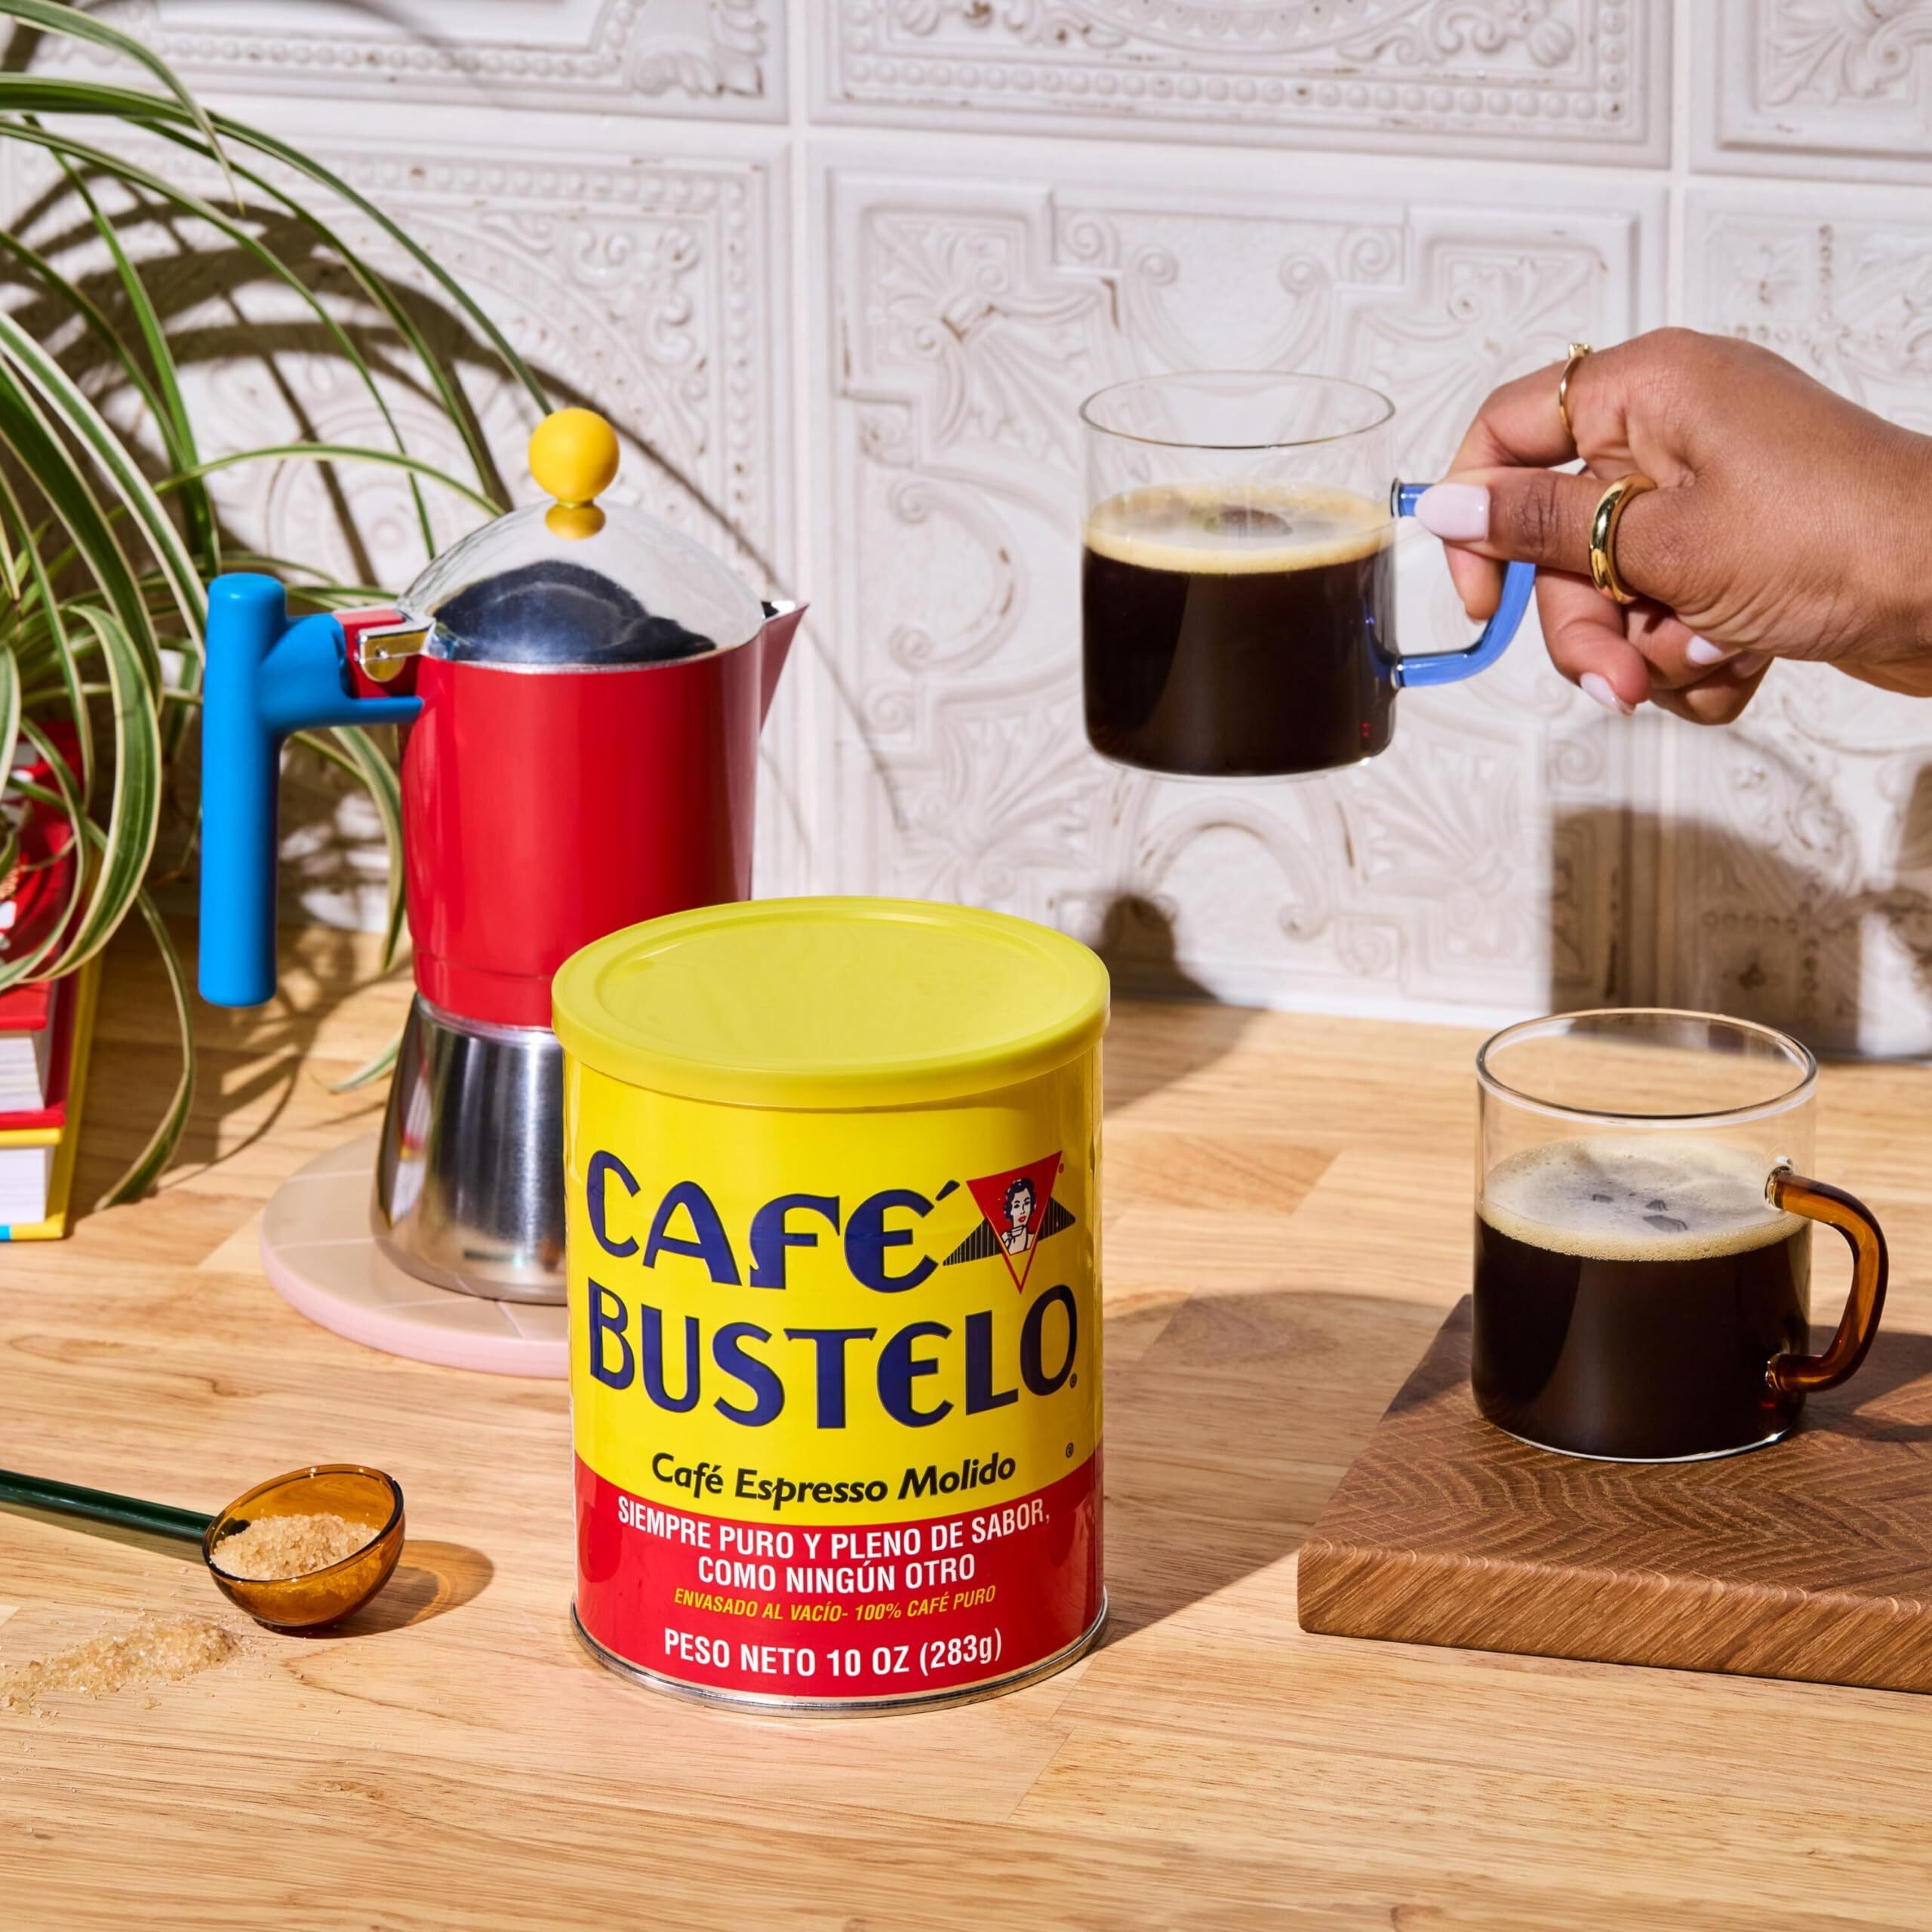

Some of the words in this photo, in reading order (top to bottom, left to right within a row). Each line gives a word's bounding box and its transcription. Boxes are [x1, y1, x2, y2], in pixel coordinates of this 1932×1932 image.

[586, 1150, 961, 1294] CAFÉ
[652, 1453, 723, 1498] Café
[735, 1468, 888, 1511] Espresso
[897, 1452, 1016, 1500] Molido
[617, 1495, 712, 1549] SIEMPRE
[719, 1524, 795, 1559] PURO
[802, 1533, 822, 1560] Y
[831, 1527, 921, 1560] PLENO
[931, 1521, 964, 1552] DE
[971, 1498, 1050, 1544] SABOR,
[698, 1555, 777, 1592] COMO
[786, 1559, 895, 1594] NINGÚN
[905, 1553, 975, 1589] OTRO
[674, 1587, 758, 1618] ENVASADO
[761, 1602, 783, 1620] AL
[855, 1603, 902, 1621] 100%
[907, 1591, 949, 1617] CAFÉ
[953, 1585, 996, 1610] PURO
[664, 1627, 731, 1669] PESO
[740, 1643, 816, 1677] NETO
[826, 1649, 861, 1677] 10
[872, 1644, 910, 1675] OZ
[919, 1626, 1002, 1677] (283g)
